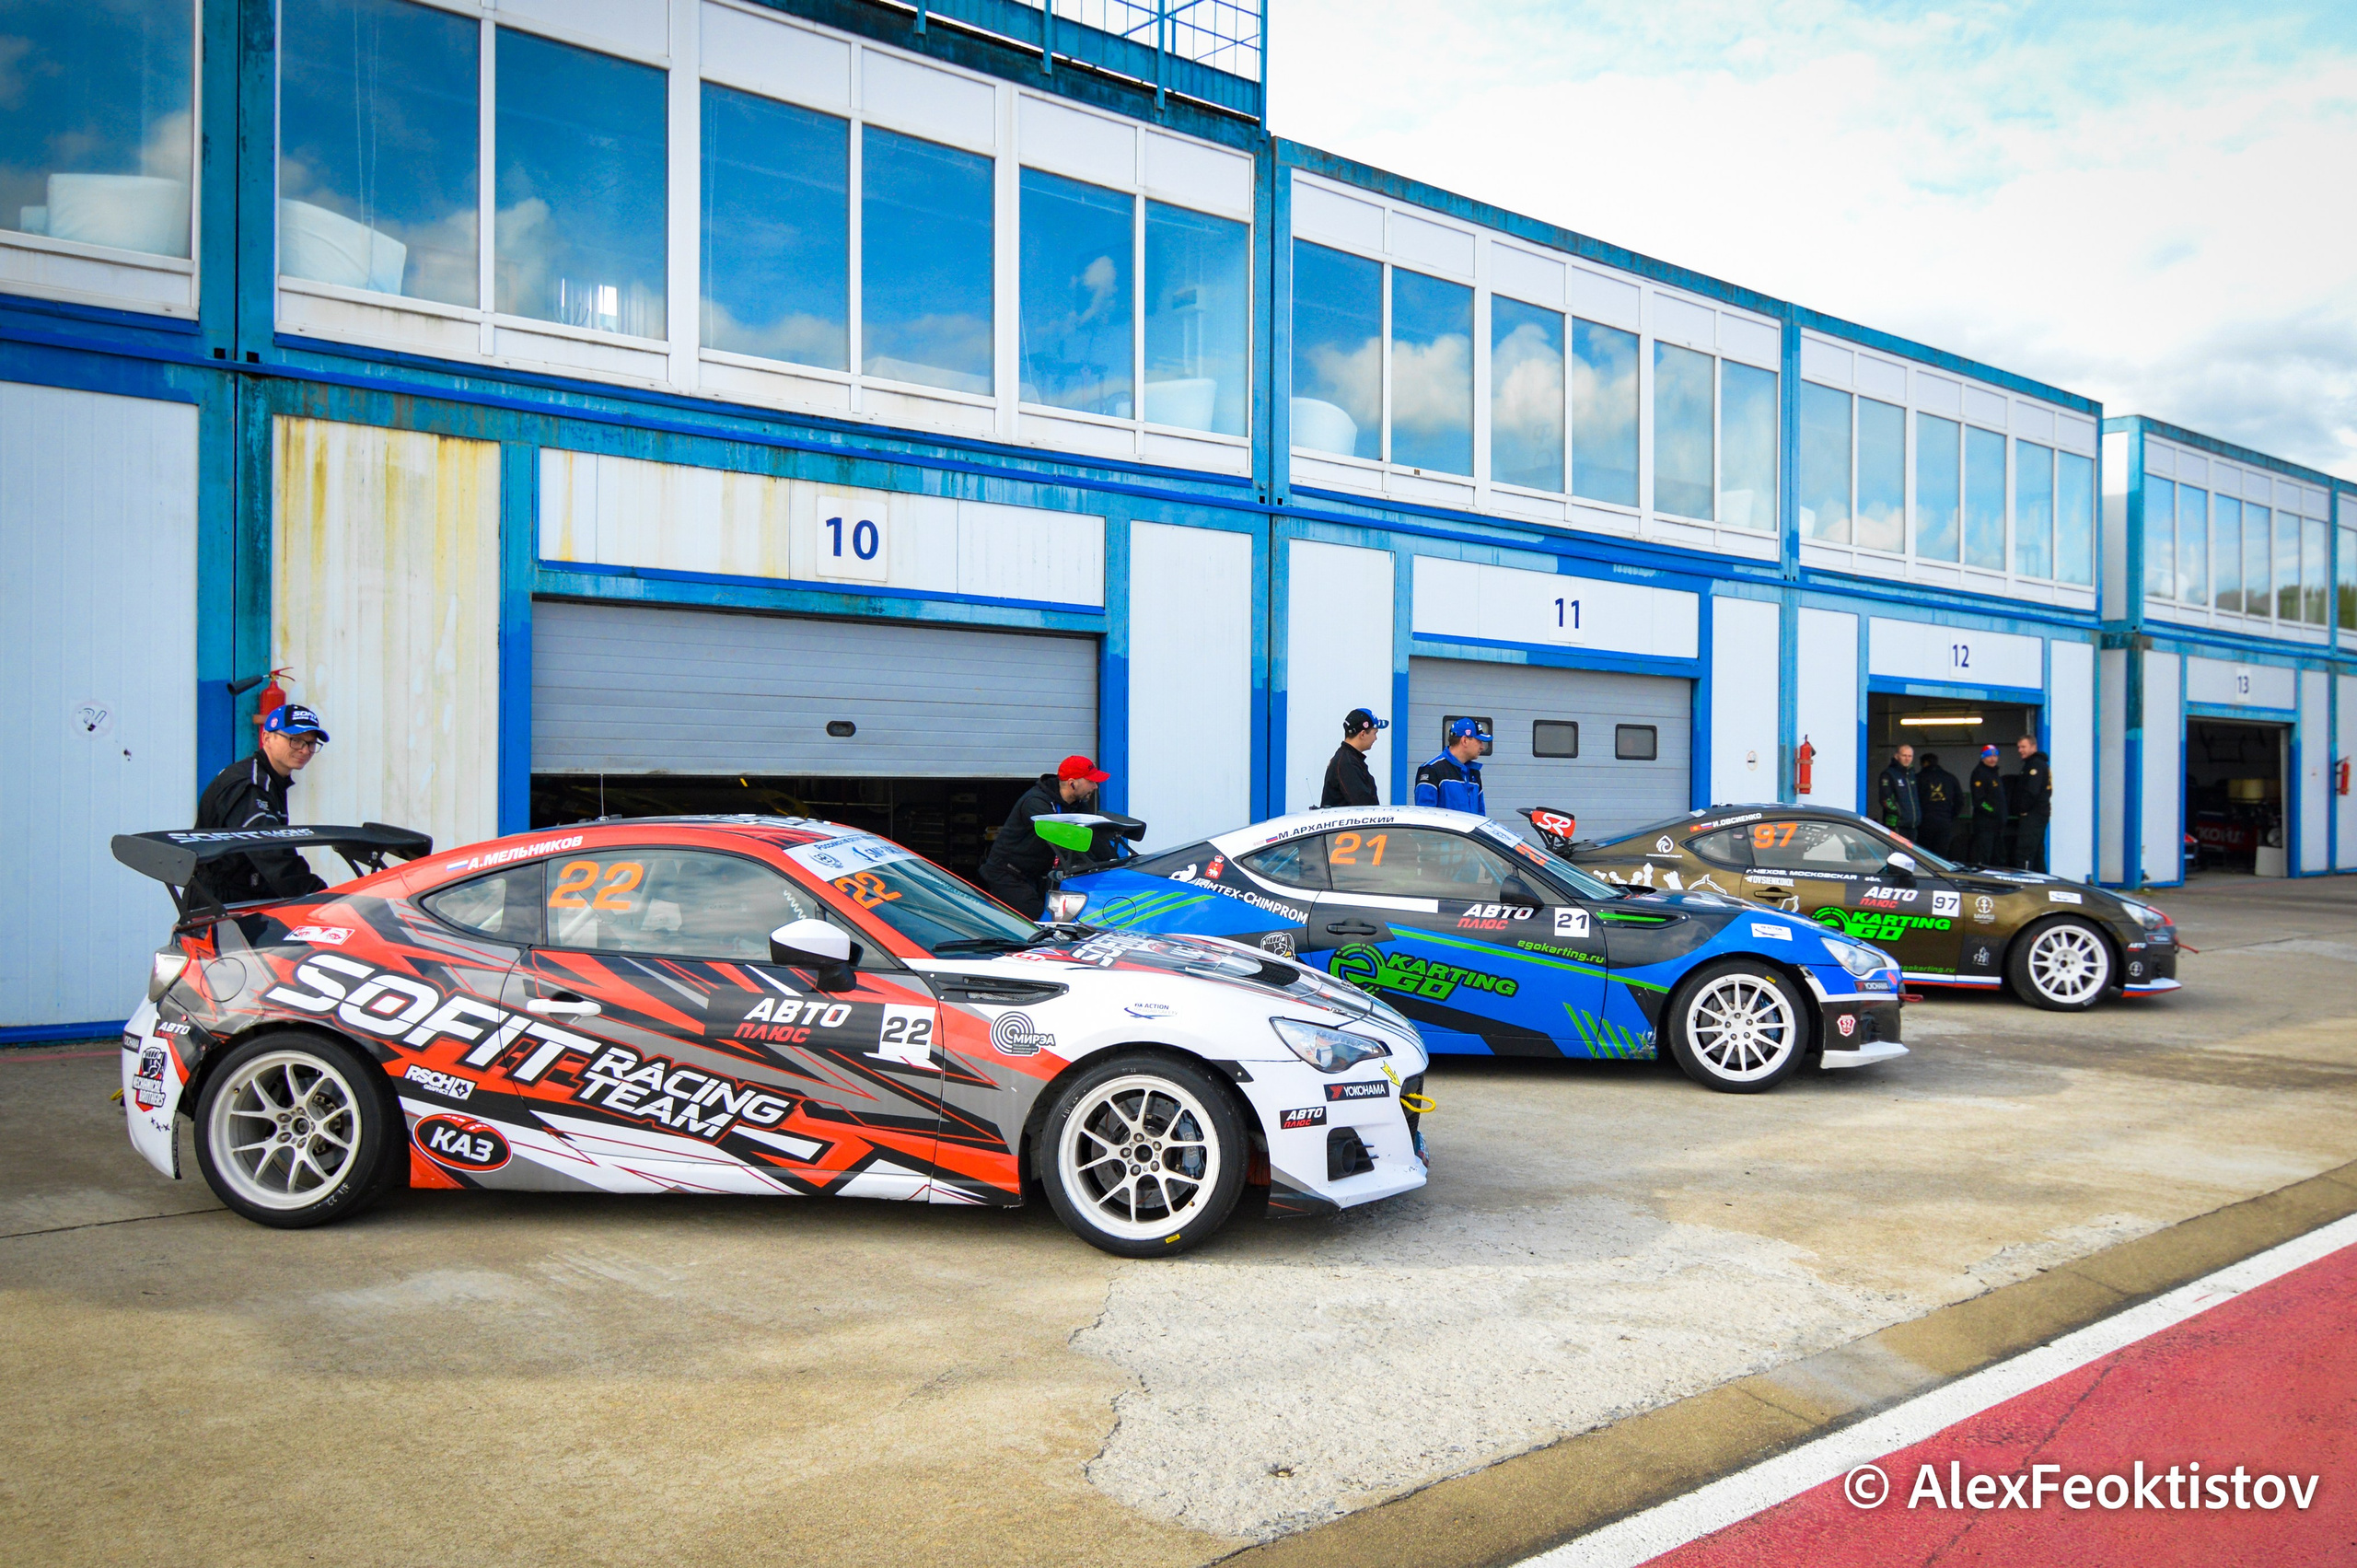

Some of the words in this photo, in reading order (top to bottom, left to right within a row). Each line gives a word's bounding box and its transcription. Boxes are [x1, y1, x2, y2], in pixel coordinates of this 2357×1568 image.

[825, 517, 879, 561] 10
[1554, 598, 1580, 629] 11
[1952, 645, 1969, 668] 12
[2237, 675, 2249, 693] 13
[1278, 815, 1395, 840] М.АРХАНГЕЛЬСКИЙ
[1753, 822, 1798, 849] 97
[467, 835, 584, 871] А.МЕЛЬНИКОВ
[1329, 832, 1387, 866] 21
[547, 860, 644, 910] 22
[1789, 870, 1858, 881] МОСКОВСКАЯ
[834, 872, 902, 910] 22
[1864, 887, 1919, 901] АВТО
[1463, 904, 1535, 920] АВТО
[1859, 898, 1899, 909] ПЛЮС
[1933, 897, 1958, 911] 97
[1456, 918, 1509, 930] ПЛЮС
[1556, 912, 1589, 930] 21
[1851, 912, 1951, 931] KARTING
[1517, 939, 1606, 964] egokarting.ru
[1387, 954, 1517, 996] KARTING
[264, 954, 602, 1084] SOFIT
[743, 997, 853, 1028] АВТО
[158, 1021, 191, 1035] АВТО
[734, 1022, 811, 1044] ПЛЮС
[881, 1016, 933, 1047] 22
[1014, 1033, 1055, 1045] МИРЭА
[404, 1064, 457, 1091] RSCH
[590, 1048, 791, 1125] RACING
[1343, 1084, 1386, 1098] YOKOHAMA
[577, 1071, 734, 1139] TEAM
[1286, 1107, 1324, 1121] АВТО
[1283, 1119, 1312, 1129] ПЛЮС
